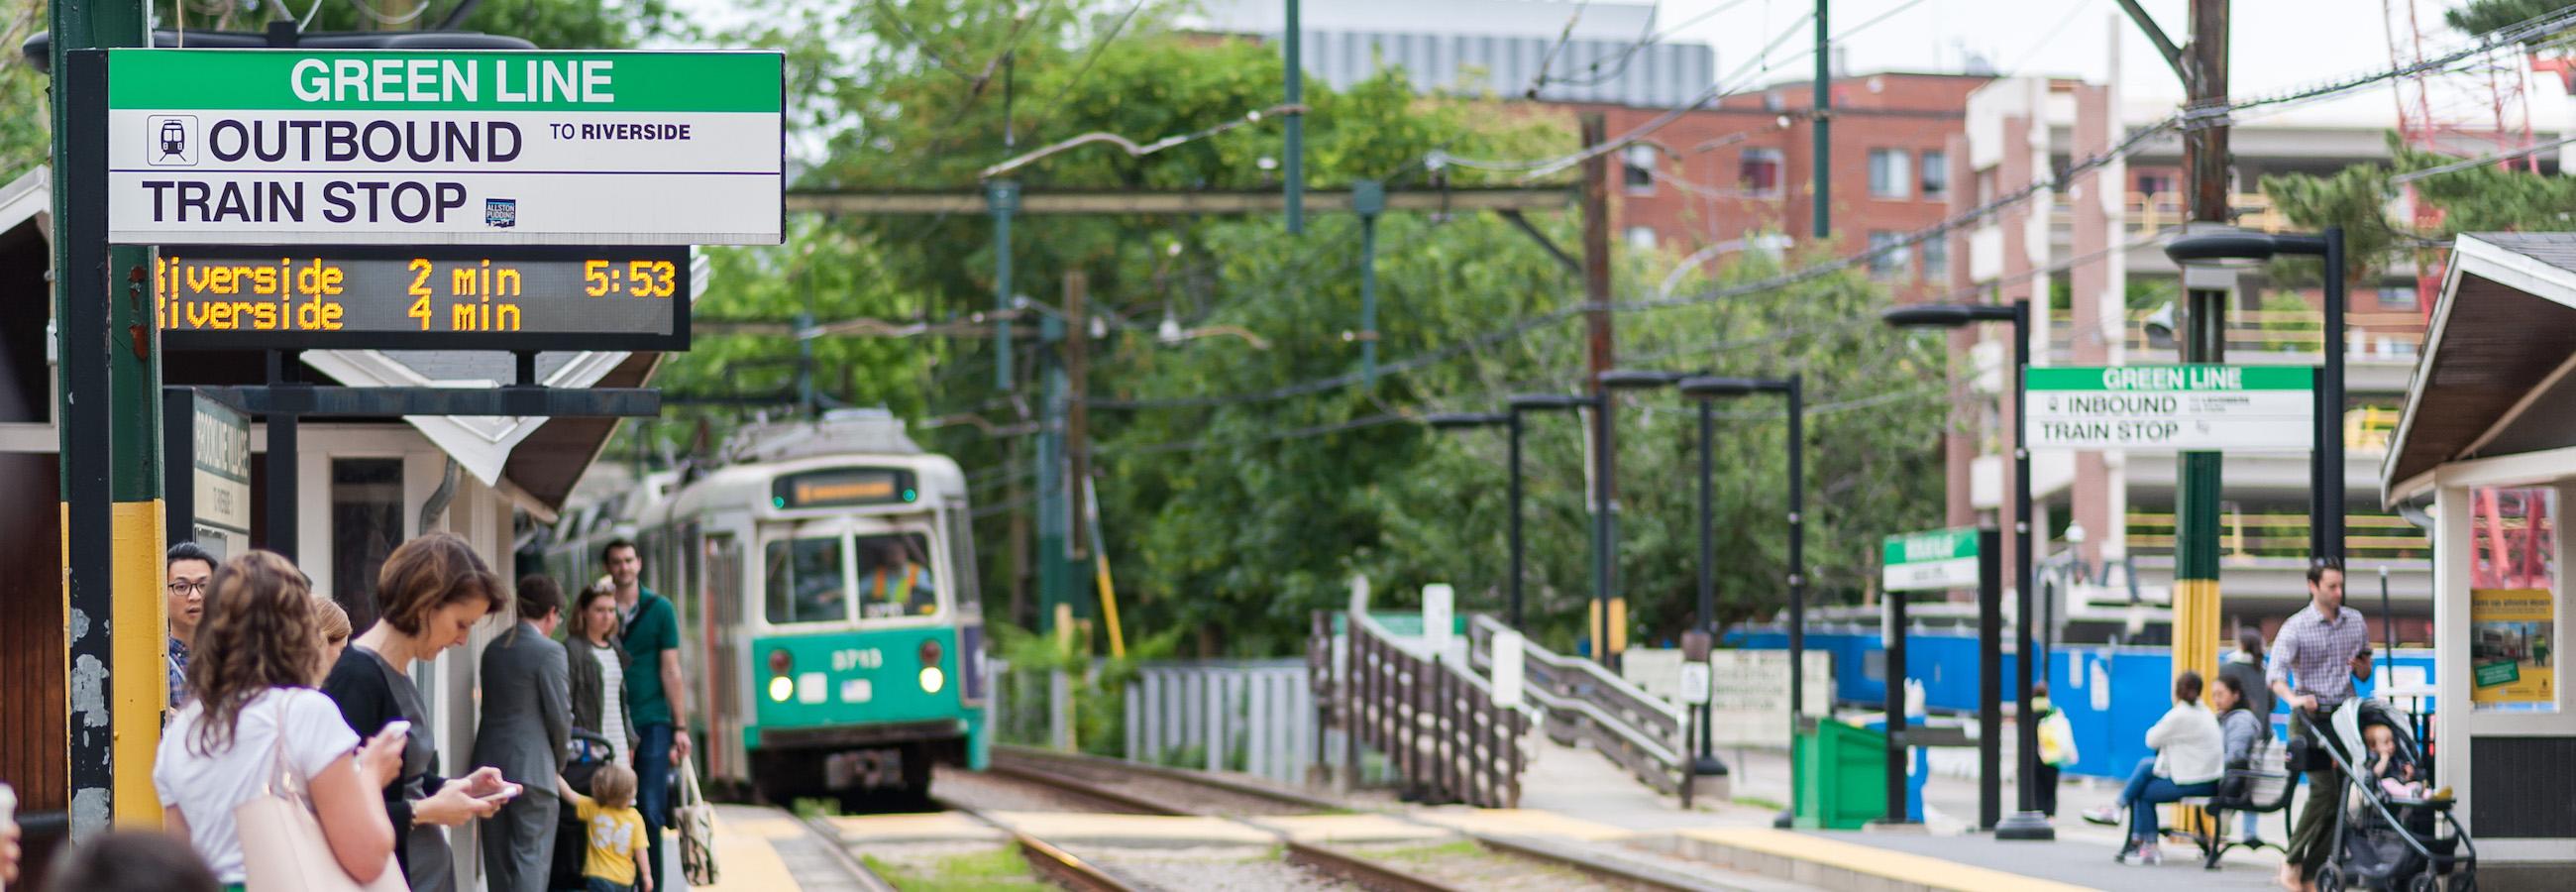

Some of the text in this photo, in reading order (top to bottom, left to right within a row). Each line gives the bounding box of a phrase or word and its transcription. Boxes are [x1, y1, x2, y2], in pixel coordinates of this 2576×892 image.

[290, 58, 614, 102] GREEN LINE
[209, 119, 522, 163] OUTBOUND
[550, 123, 691, 140] TO RIVERSIDE
[142, 180, 468, 223] TRAIN STOP
[407, 258, 433, 295] 2
[452, 259, 522, 296] min
[585, 259, 676, 297] 5:53
[407, 294, 433, 332] 4
[452, 295, 522, 332] min
[2101, 367, 2242, 390] GREEN LINE
[2068, 395, 2178, 414] INBOUND
[2041, 421, 2180, 441] TRAIN STOP
